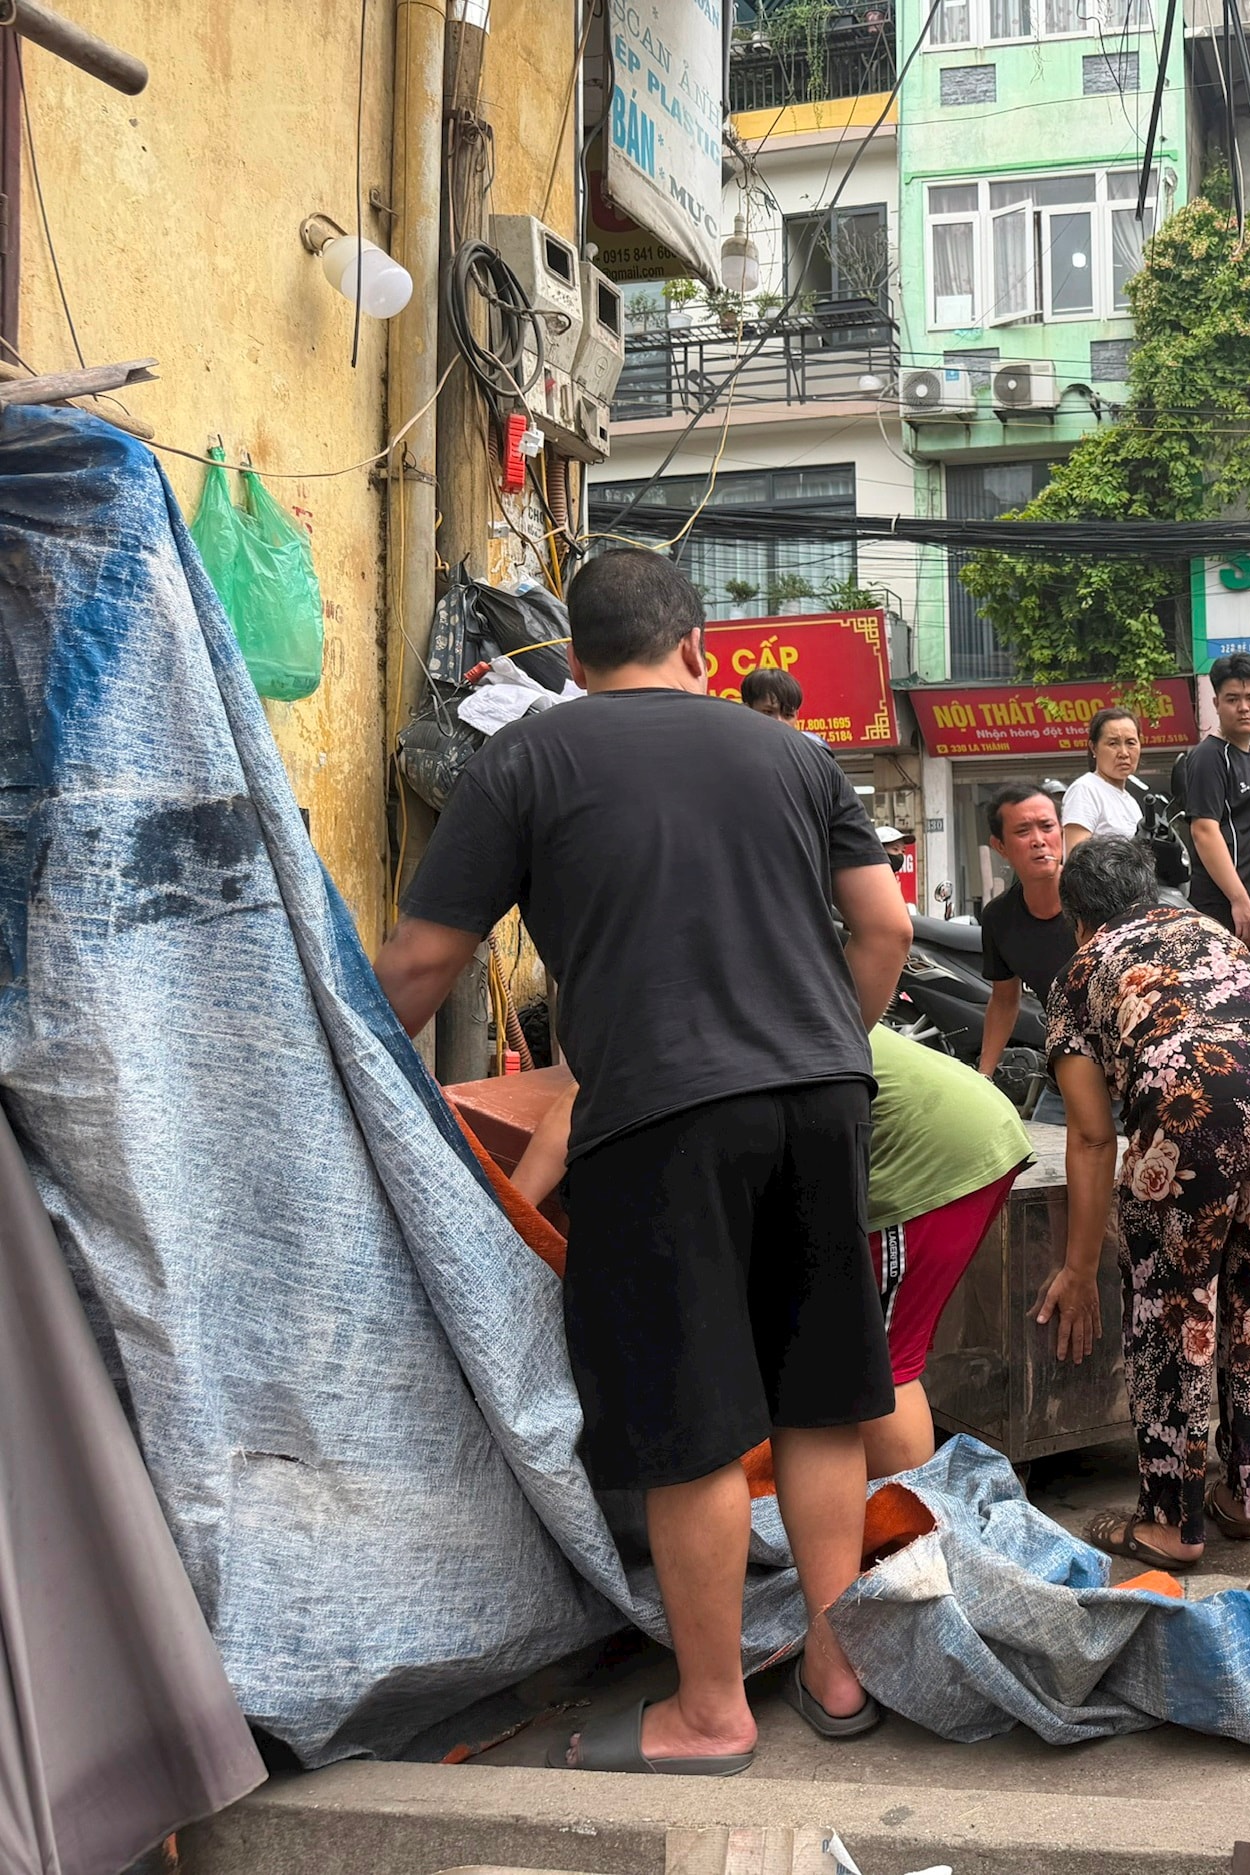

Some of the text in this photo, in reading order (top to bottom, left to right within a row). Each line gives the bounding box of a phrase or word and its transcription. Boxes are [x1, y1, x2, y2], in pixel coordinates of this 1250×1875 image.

[613, 84, 655, 179] BÁN
[647, 69, 720, 167] PLASTIC
[603, 249, 630, 264] 0915
[633, 246, 653, 262] 841
[732, 635, 799, 676] CẤP
[932, 703, 976, 733] NỘI
[979, 694, 1037, 728] THẤT
[1010, 726, 1040, 739] hàng
[1043, 725, 1064, 738] đặt
[981, 741, 1010, 751] THÀNH
[887, 1231, 899, 1278] LAGERFELD
